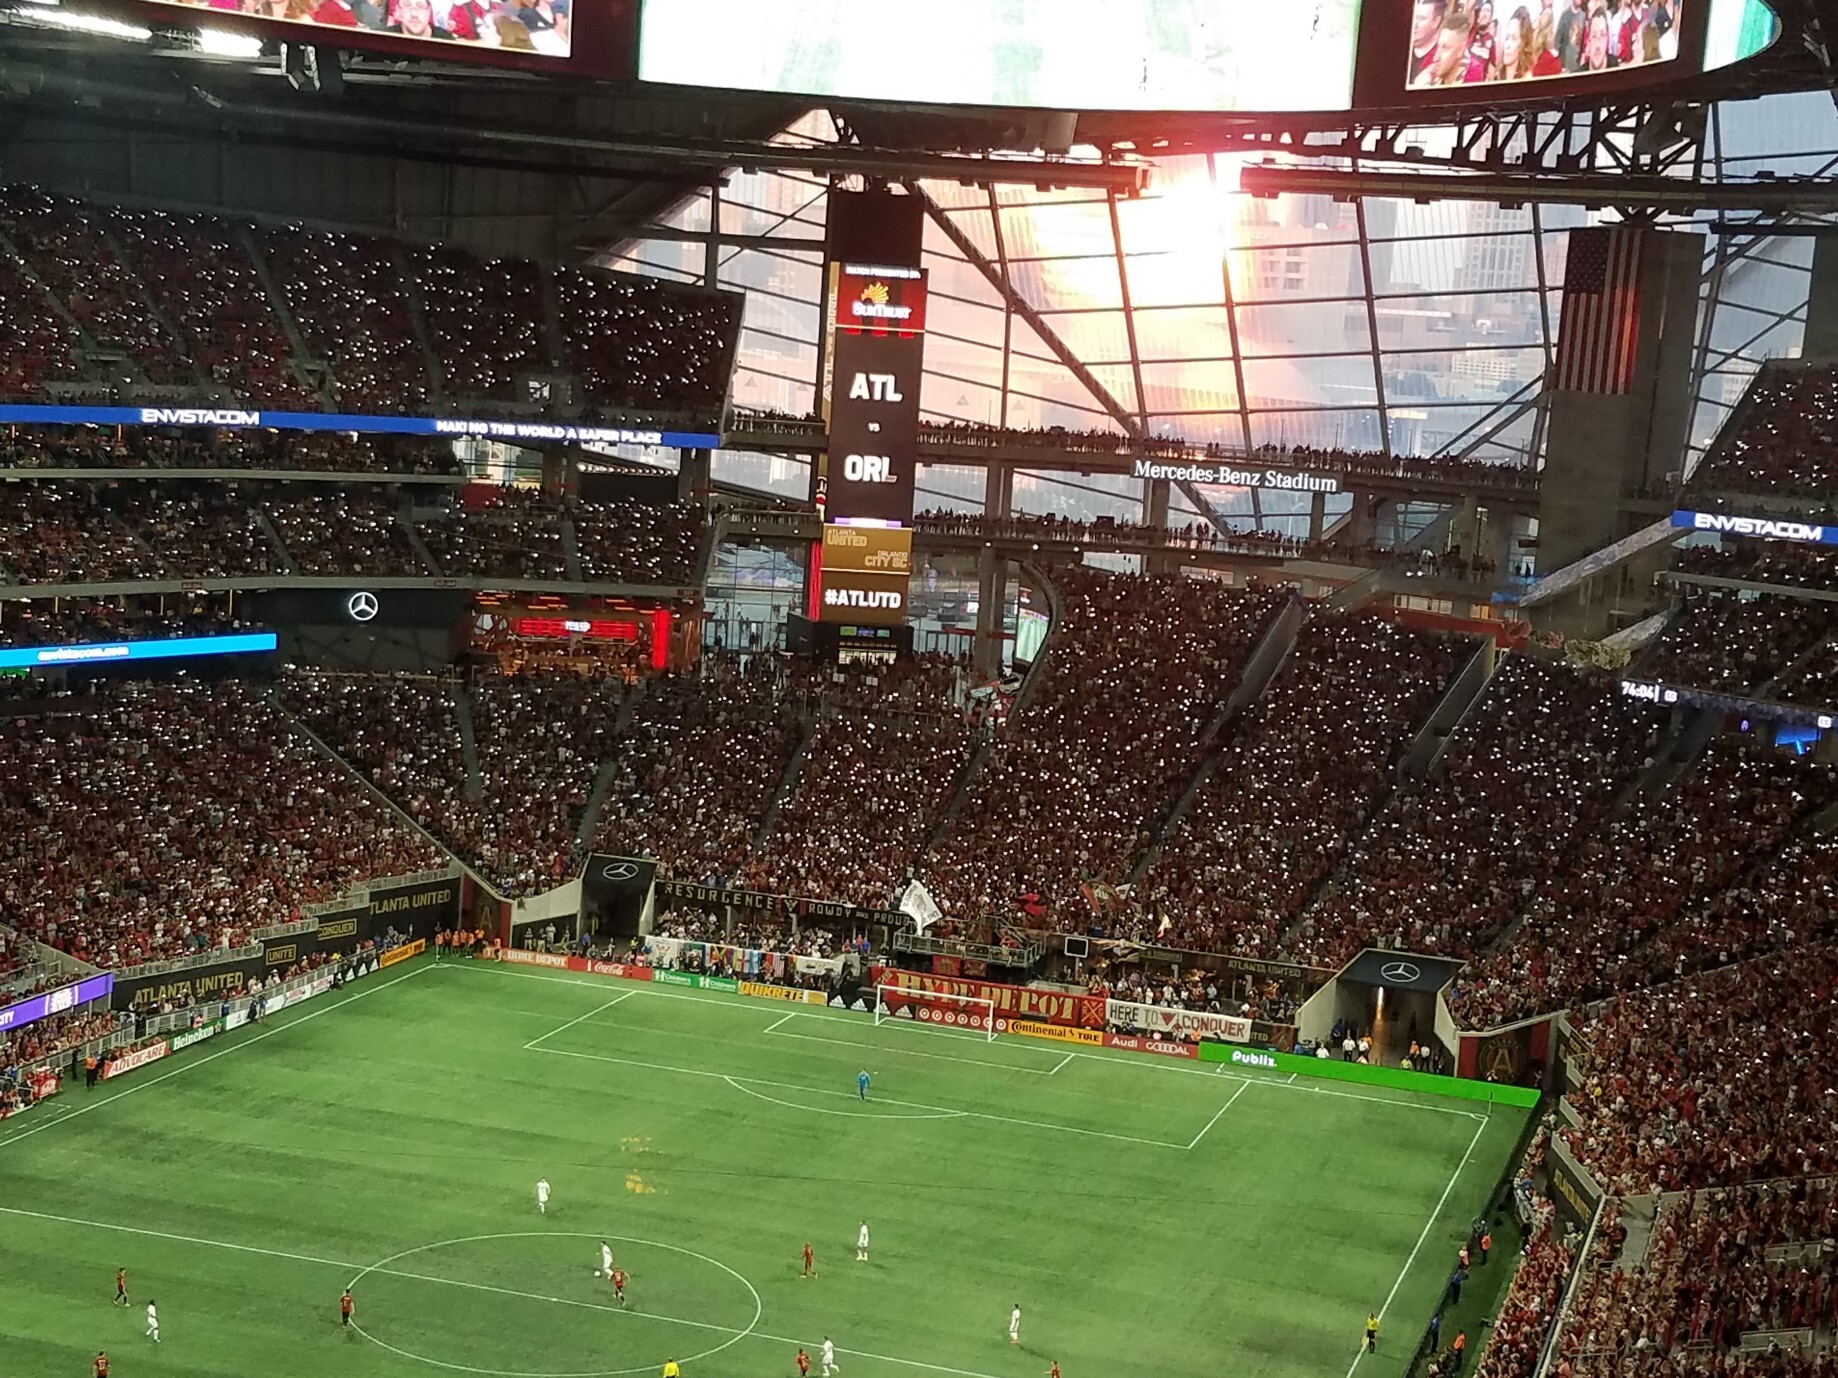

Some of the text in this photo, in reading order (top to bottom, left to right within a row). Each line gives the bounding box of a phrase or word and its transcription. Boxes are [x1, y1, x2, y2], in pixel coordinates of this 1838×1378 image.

[849, 372, 903, 401] ATL
[142, 408, 260, 425] ENVISTACOM
[490, 423, 516, 436] THE
[518, 425, 565, 439] WORLD
[566, 428, 577, 439] A
[621, 431, 662, 444] PLACE
[844, 454, 897, 483] ORL
[1134, 460, 1337, 492] Mercedes-Benz Stadium
[1694, 513, 1822, 541] ENVISTACOM
[827, 535, 867, 547] UNITED
[864, 555, 890, 567] CITY
[877, 550, 908, 558] ORLANDO
[825, 588, 902, 609] #ATLUTD
[368, 889, 451, 915] TLANTA UNITED
[665, 883, 774, 909] RESURGENCE
[809, 903, 852, 918] ROWDY
[873, 913, 911, 926] PROUD
[269, 947, 294, 962] UNITE
[507, 950, 534, 962] HOME
[536, 953, 567, 967] DEPOT
[1228, 960, 1267, 974] ATLANTA
[134, 971, 244, 1004] ATLANTA UNITED
[739, 981, 804, 1001] QUIKRETE
[897, 972, 1079, 1020] HYPE DEPOT
[1011, 1020, 1099, 1042] Continental TIRE
[1110, 1003, 1246, 1038] HERE TO CONQUER
[173, 1025, 215, 1051] Heineken
[1111, 1037, 1138, 1049] Audi
[1250, 1032, 1268, 1042] ITED
[111, 1043, 165, 1075] ADVOCARE
[1232, 1050, 1276, 1067] Publix
